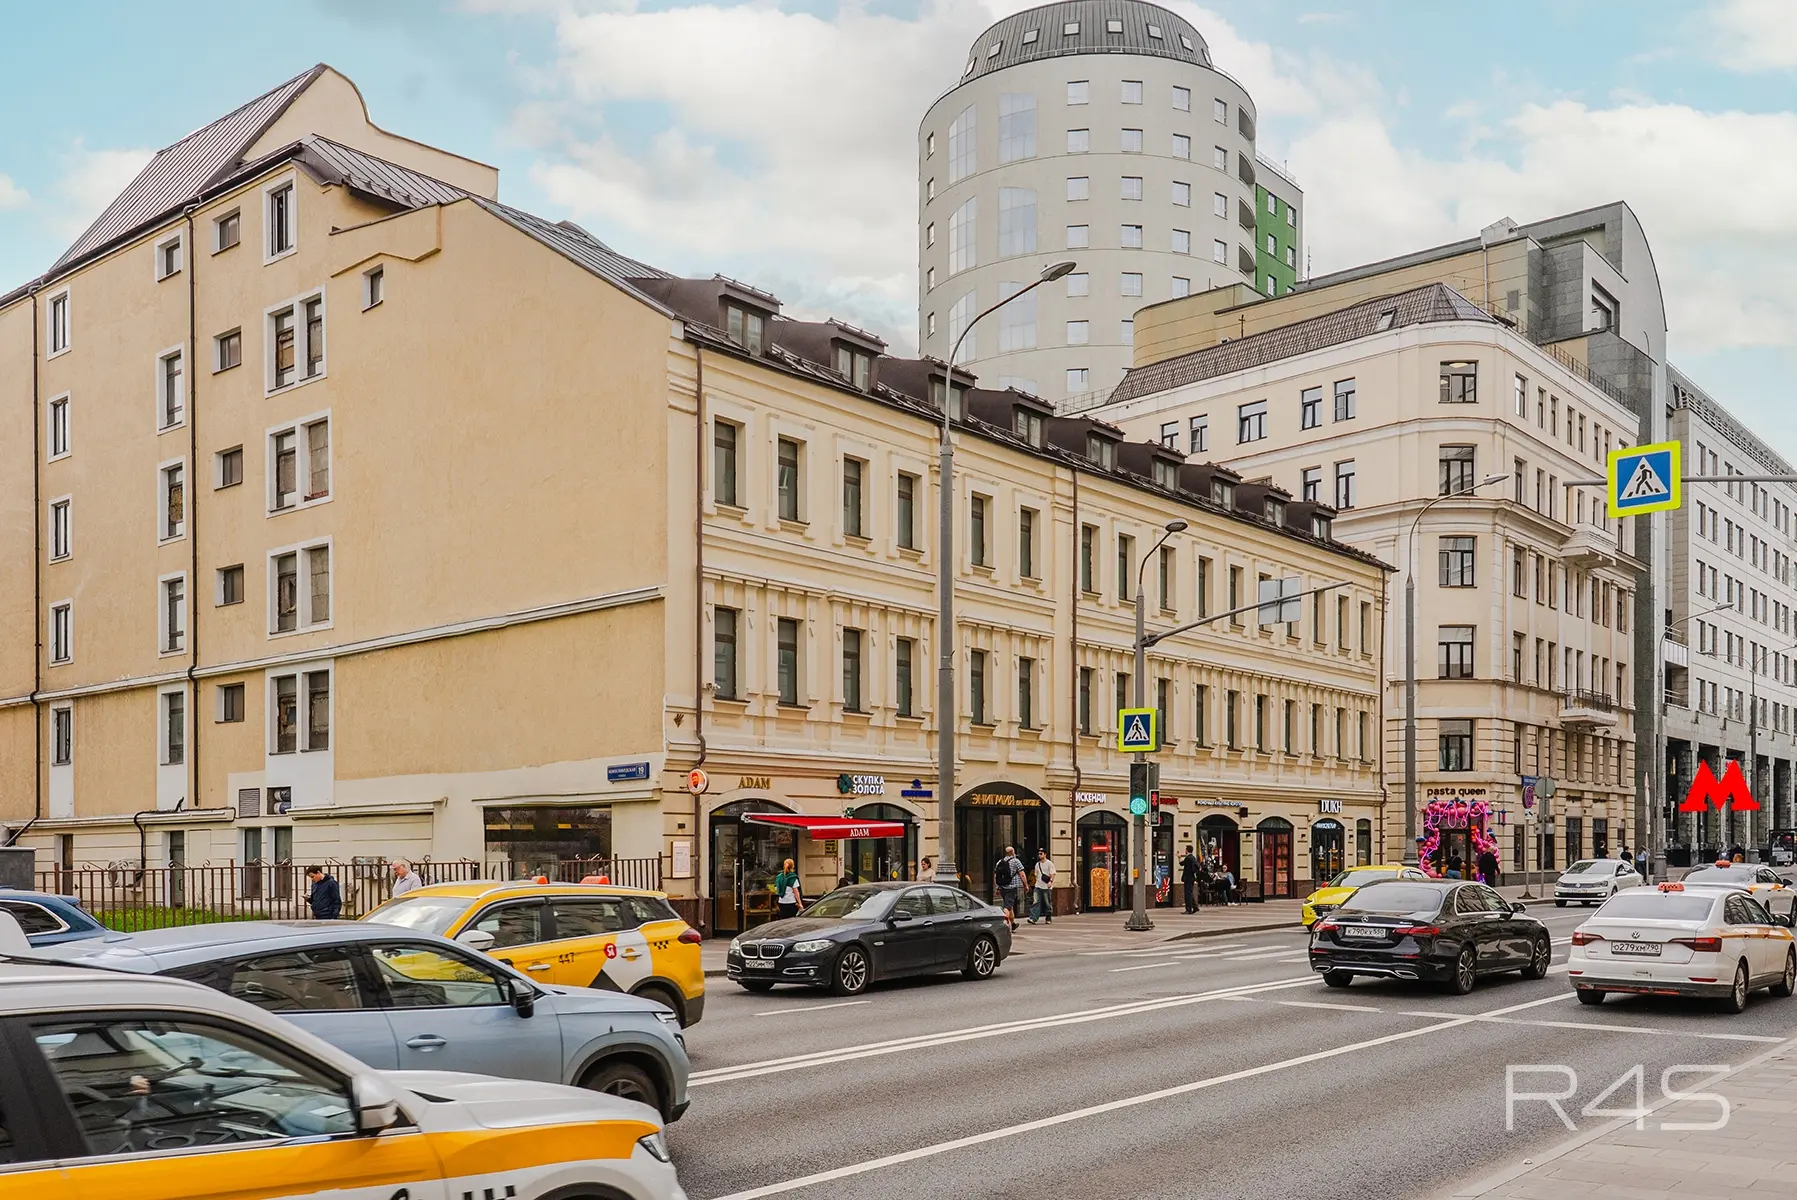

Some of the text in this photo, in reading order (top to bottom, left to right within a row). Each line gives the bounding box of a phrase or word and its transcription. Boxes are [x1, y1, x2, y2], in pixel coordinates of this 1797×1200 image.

[638, 766, 645, 775] 19
[738, 777, 771, 789] ADAM
[852, 775, 885, 785] СКУПКА
[852, 784, 885, 794] ЗОЛОТА
[1427, 787, 1487, 798] pasta queen
[849, 828, 870, 837] ADAM
[558, 952, 576, 964] 447
